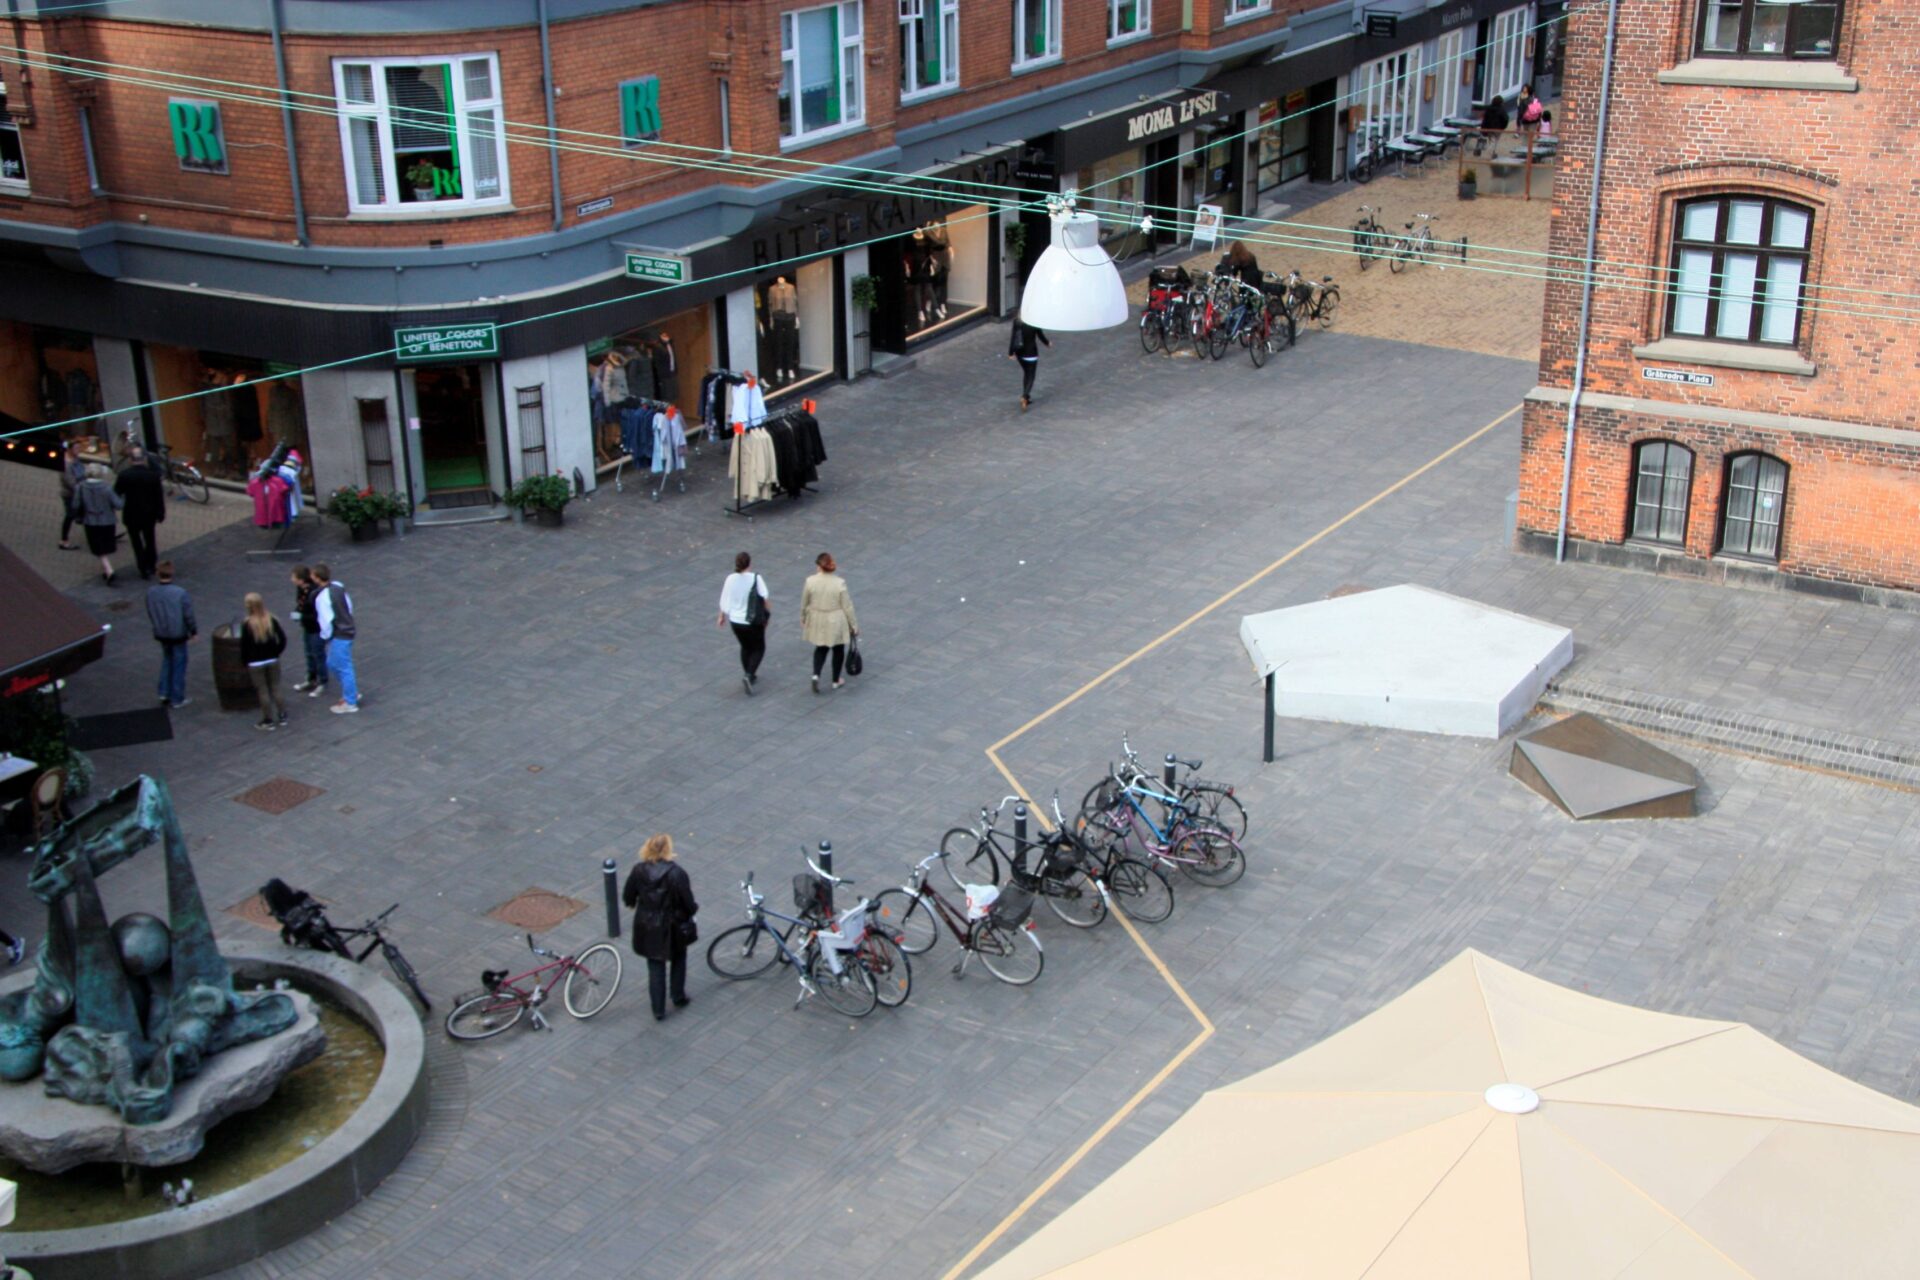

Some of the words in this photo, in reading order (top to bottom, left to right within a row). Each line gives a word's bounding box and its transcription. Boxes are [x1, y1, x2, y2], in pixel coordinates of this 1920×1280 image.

[168, 102, 223, 161] RK
[1127, 106, 1175, 142] MONA
[866, 189, 915, 235] KAI
[403, 331, 442, 344] UNITED
[446, 329, 488, 340] COLORS
[408, 344, 423, 354] OF
[1688, 374, 1710, 383] Plads
